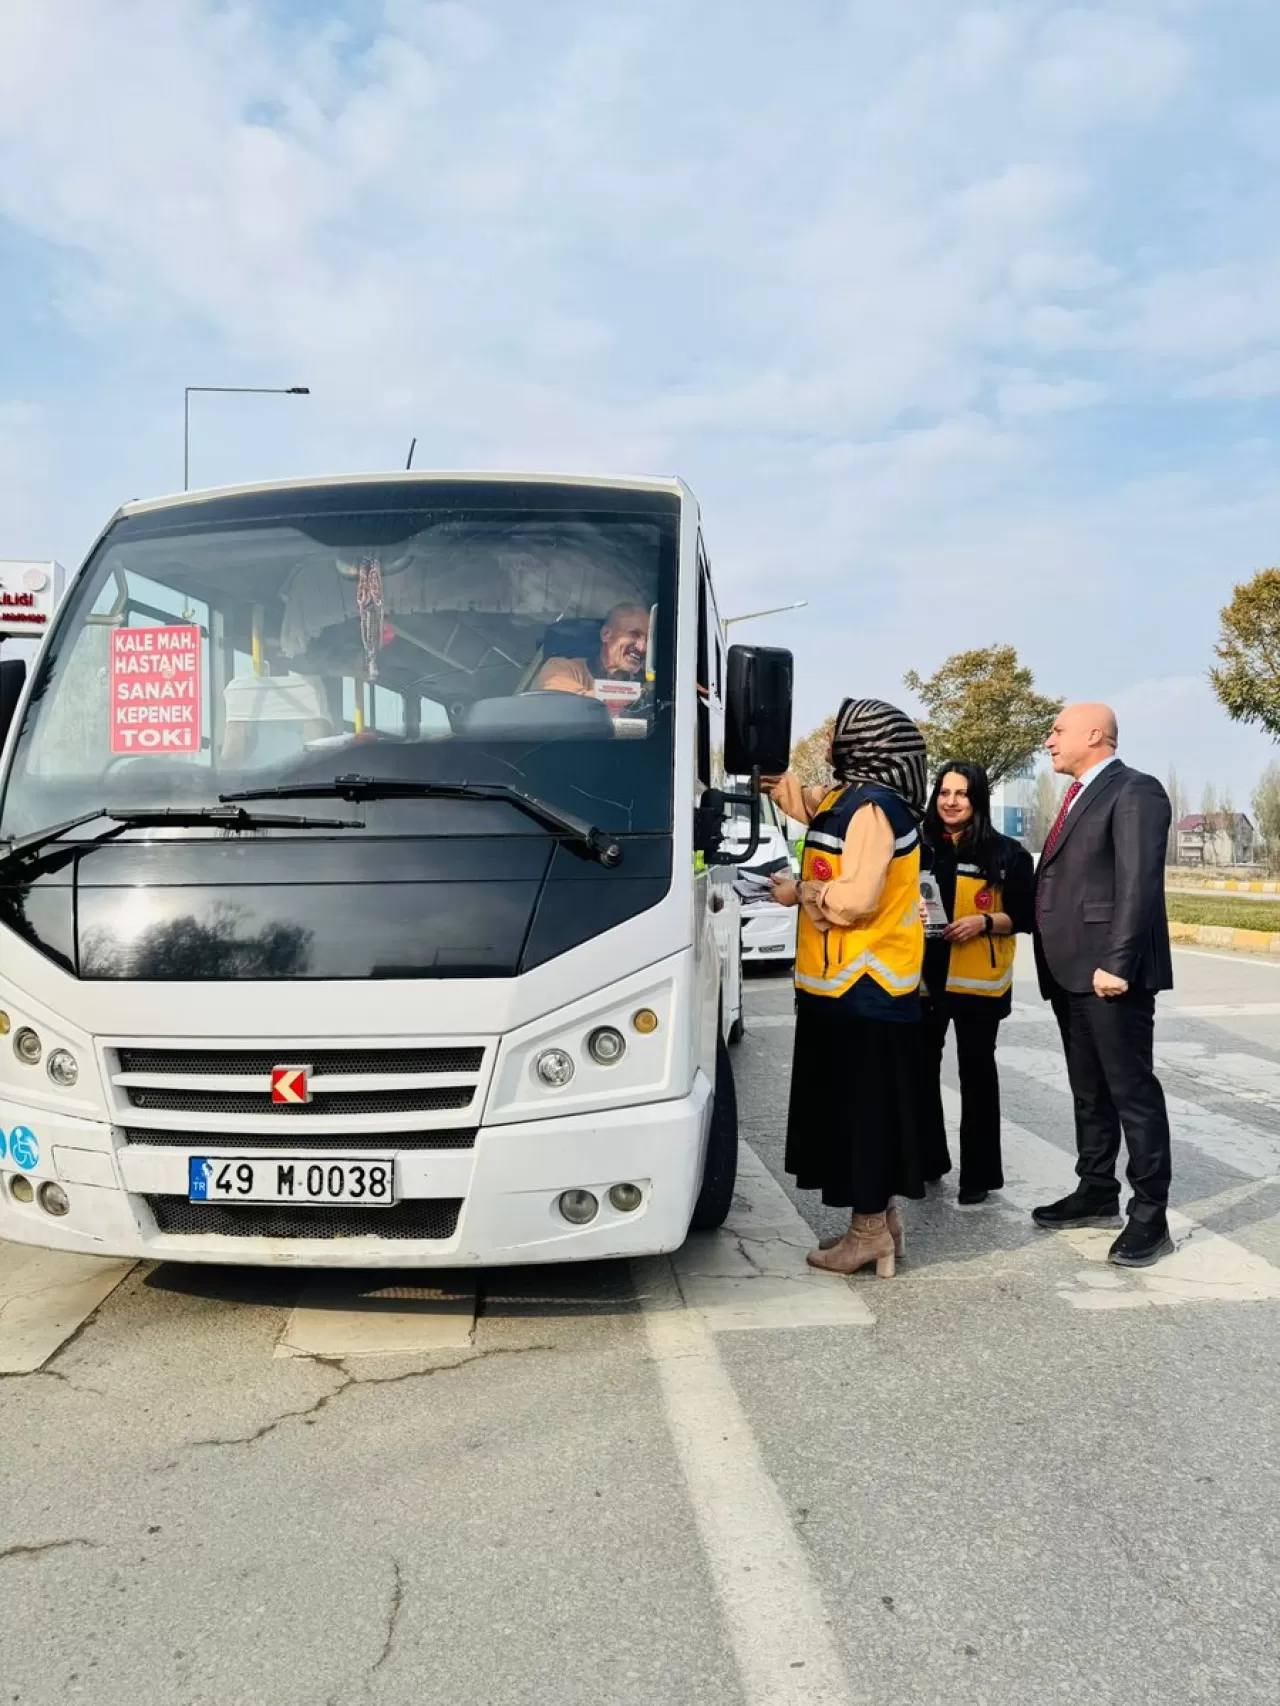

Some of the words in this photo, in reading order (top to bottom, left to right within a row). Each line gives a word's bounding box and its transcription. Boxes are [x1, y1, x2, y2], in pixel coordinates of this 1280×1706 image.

[115, 633, 153, 652] KALE
[157, 632, 195, 650] MAH.
[115, 653, 195, 674] HASTANE
[117, 677, 194, 700] SANAYİ
[117, 705, 193, 724] KEPENEK
[193, 1180, 206, 1191] TR
[216, 1163, 254, 1194] 49
[277, 1164, 294, 1195] M
[307, 1165, 387, 1197] 0038
